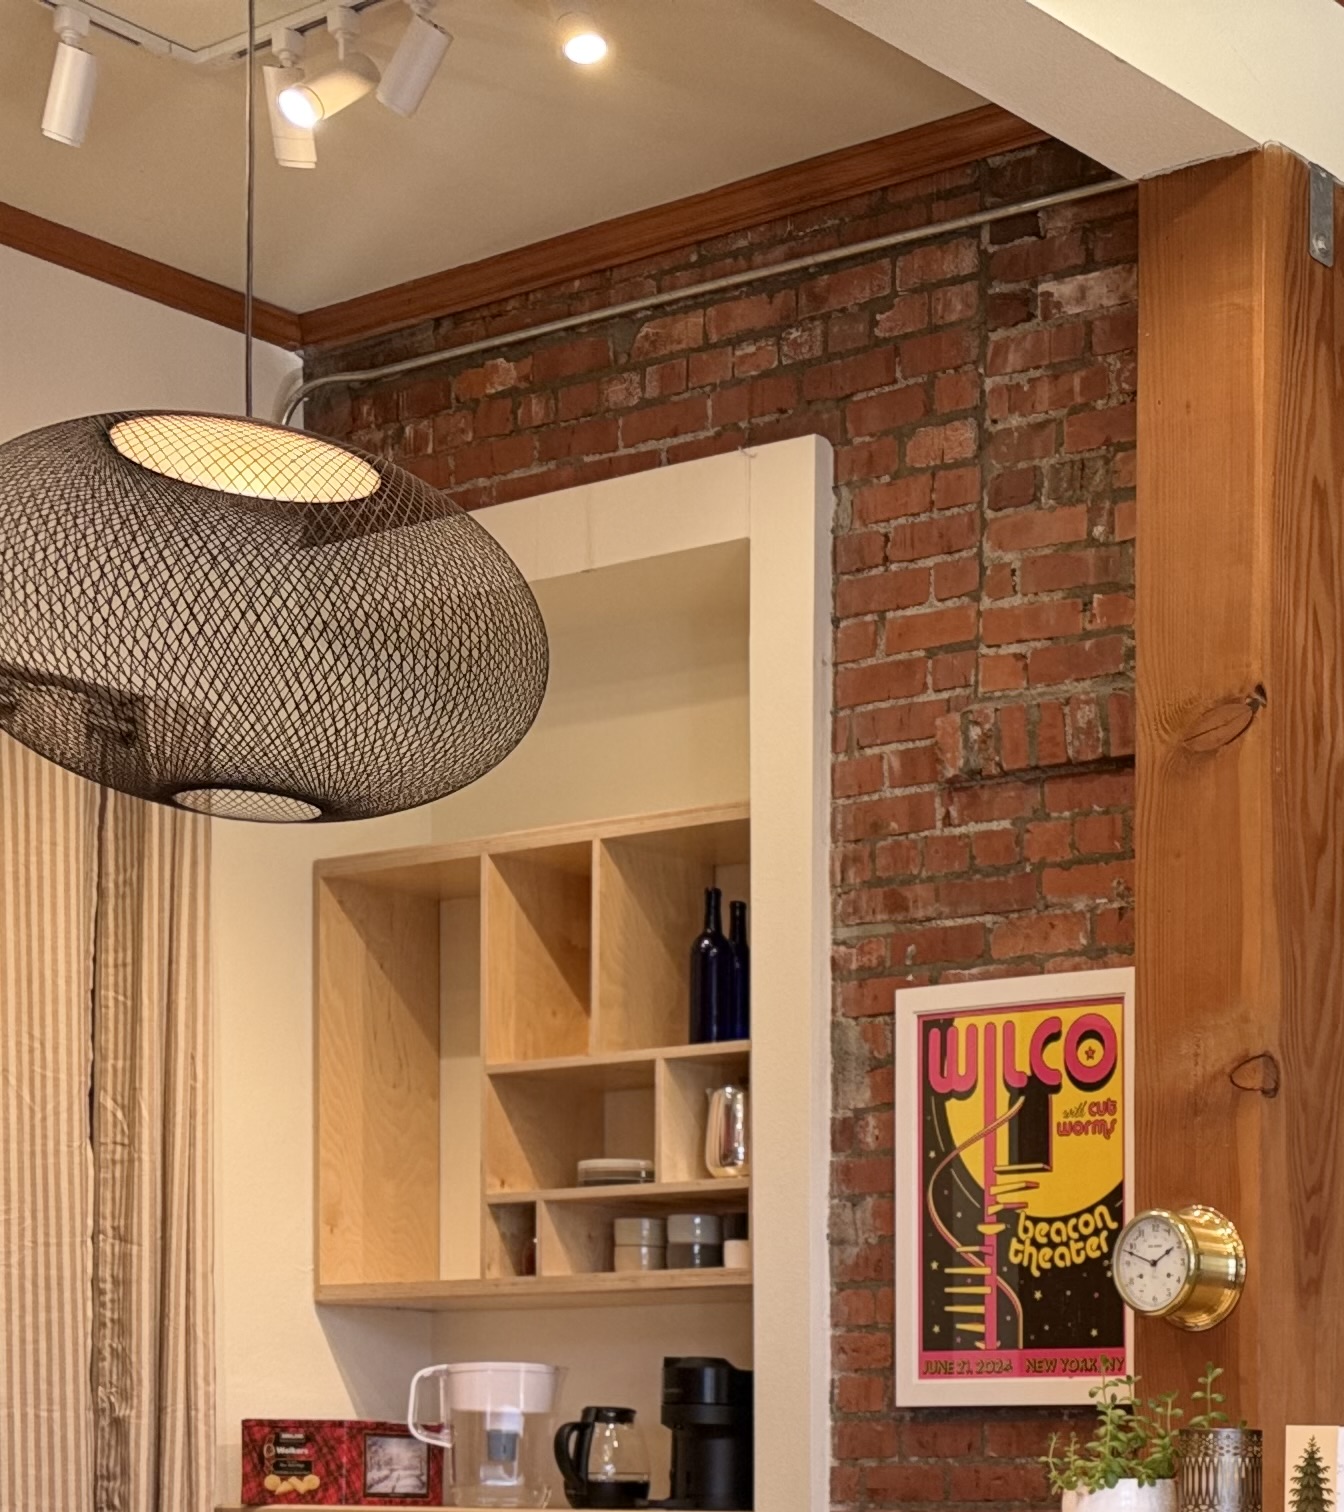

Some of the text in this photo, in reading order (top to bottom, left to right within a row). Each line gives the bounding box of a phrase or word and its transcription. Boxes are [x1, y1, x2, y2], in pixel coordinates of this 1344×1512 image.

[928, 1012, 1118, 1095] WILCO
[1088, 1098, 1117, 1116] cut
[1056, 1119, 1118, 1140] worms
[1017, 1204, 1119, 1244] beacon
[1008, 1229, 1109, 1278] theater
[922, 1359, 954, 1375] JUNE
[1025, 1357, 1058, 1373] NEW
